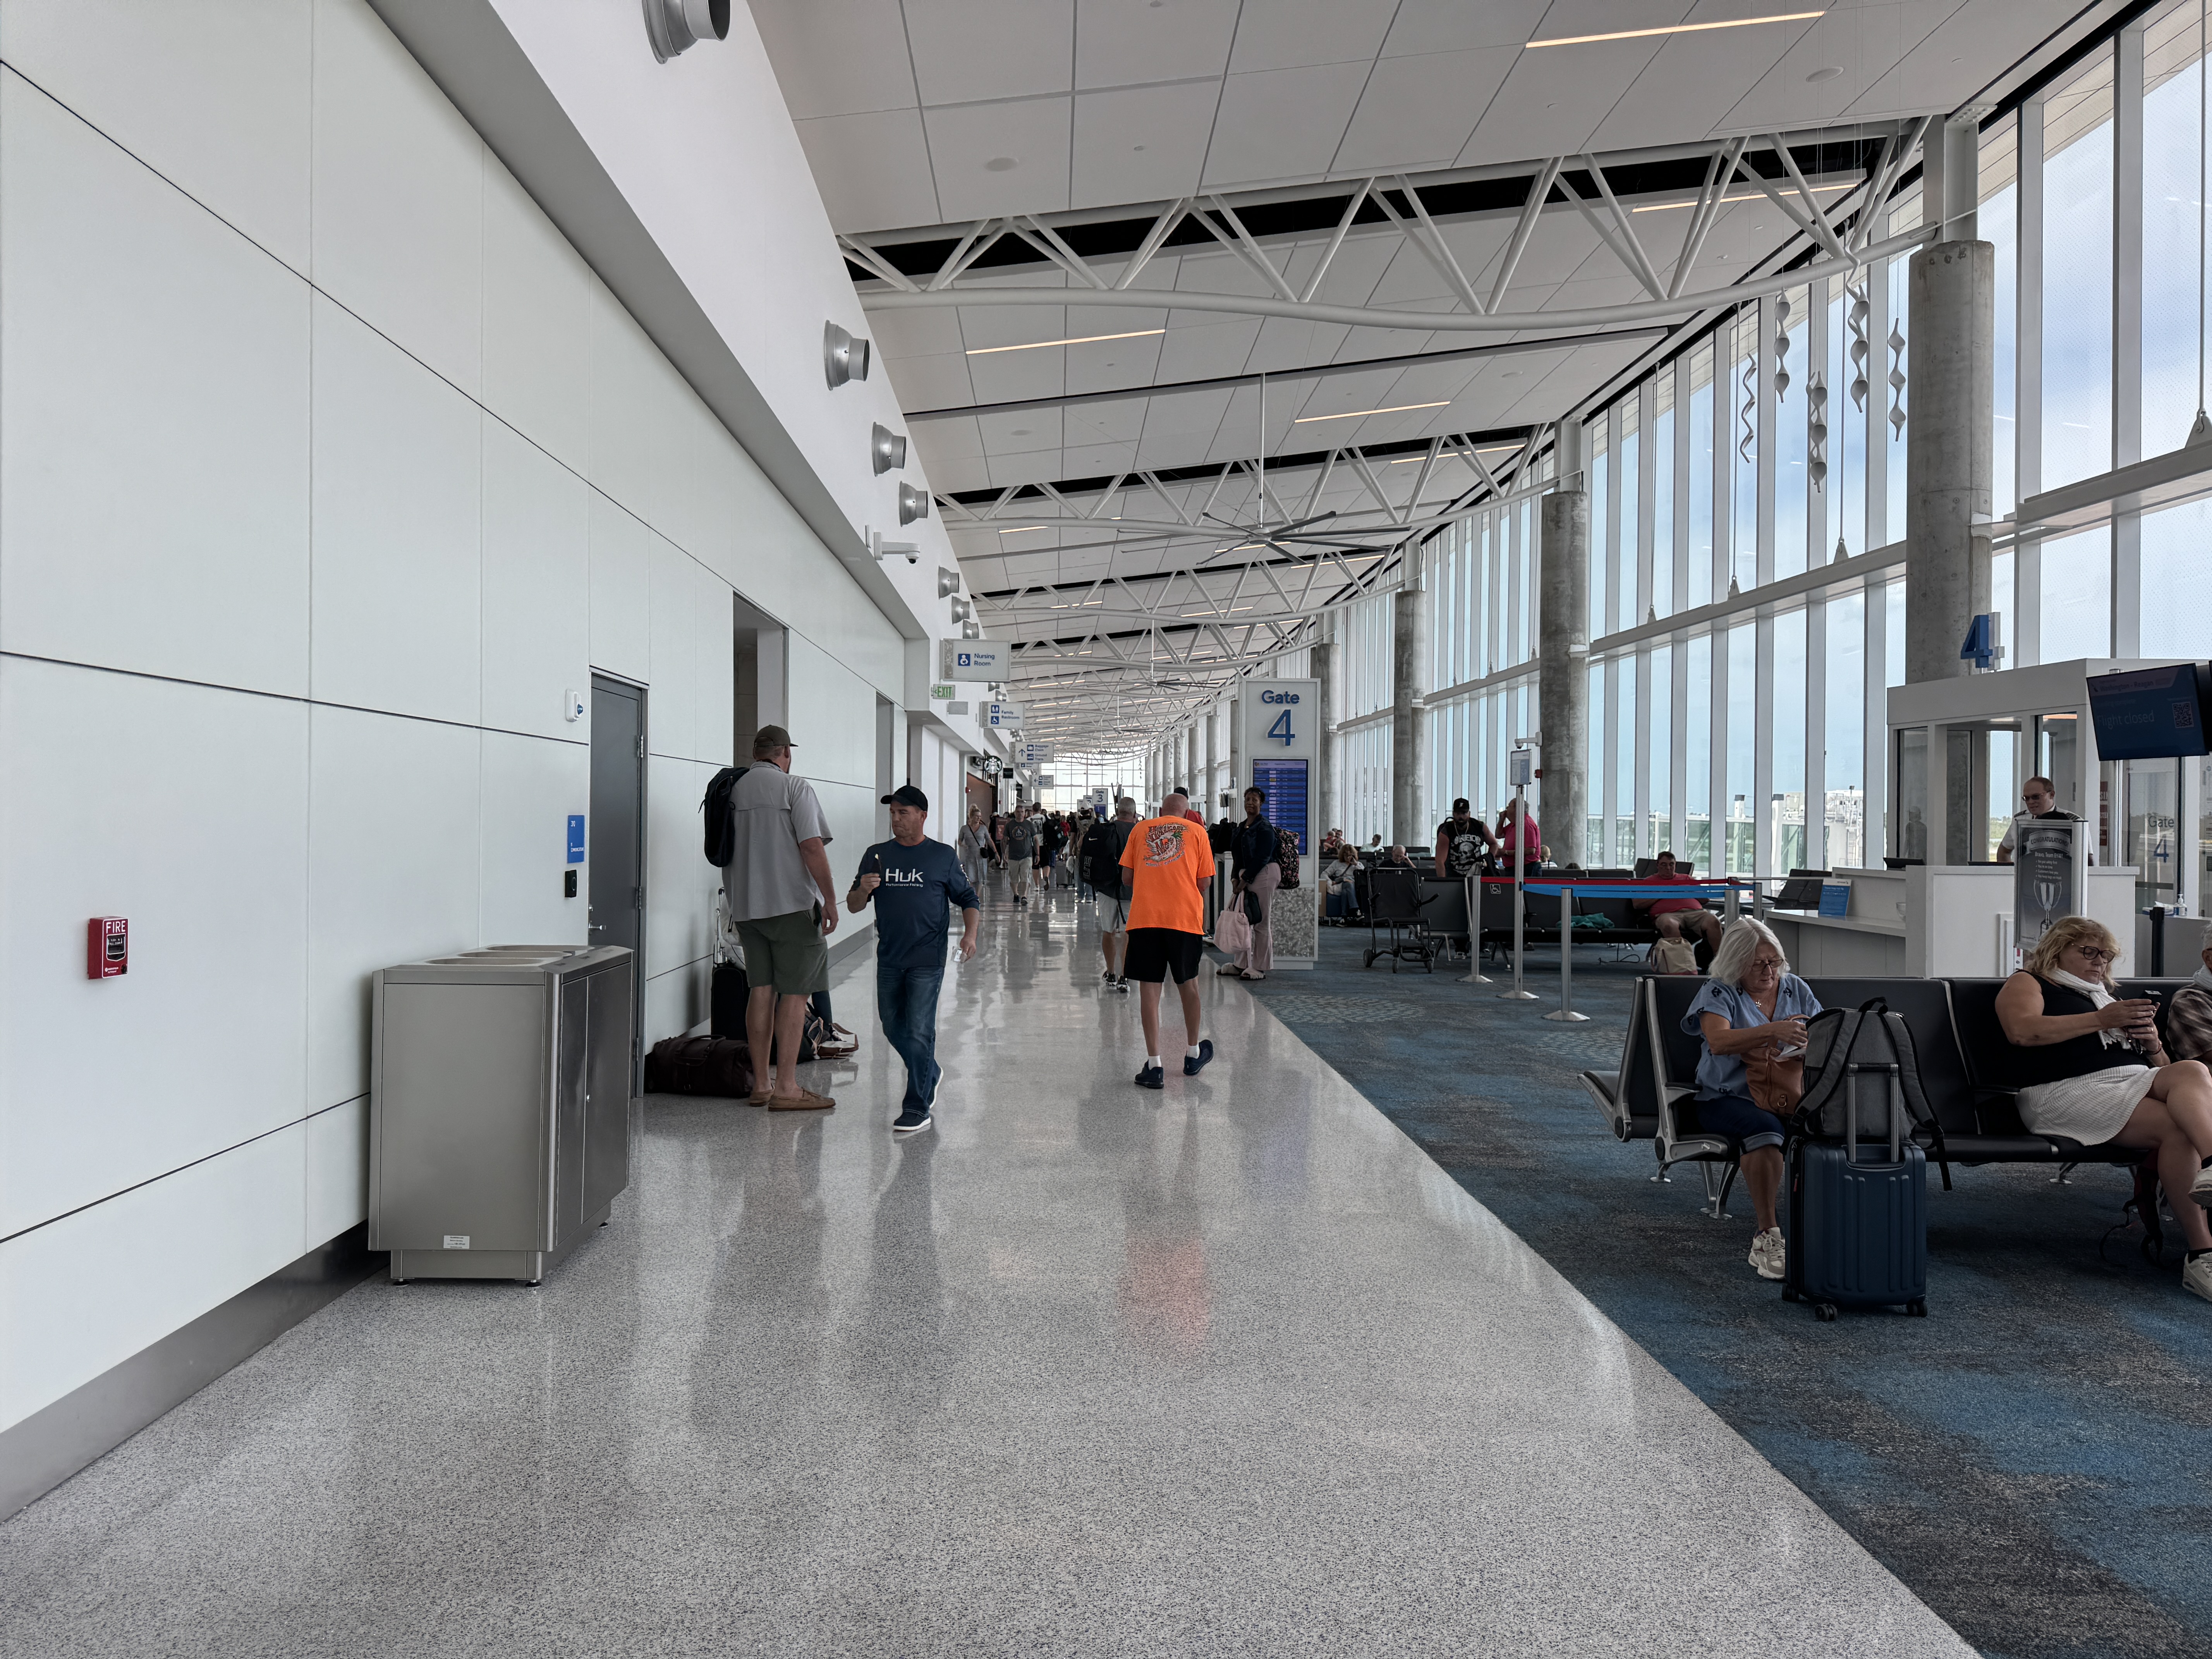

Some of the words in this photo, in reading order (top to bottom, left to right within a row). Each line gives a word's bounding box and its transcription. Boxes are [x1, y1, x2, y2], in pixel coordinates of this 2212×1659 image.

[1961, 614, 1993, 668] 4
[2134, 680, 2154, 689] Reagan
[937, 687, 952, 697] EXIT
[1261, 690, 1300, 704] Gate
[2097, 714, 2122, 730] Flight
[2124, 709, 2155, 724] closed
[1267, 709, 1295, 746] 4
[1097, 794, 1103, 802] 3
[2149, 816, 2174, 828] Gate
[2031, 836, 2069, 847] CONGRATULATIONS!
[2153, 834, 2169, 863] 4
[885, 868, 923, 882] Huk
[106, 921, 126, 934] FIRE
